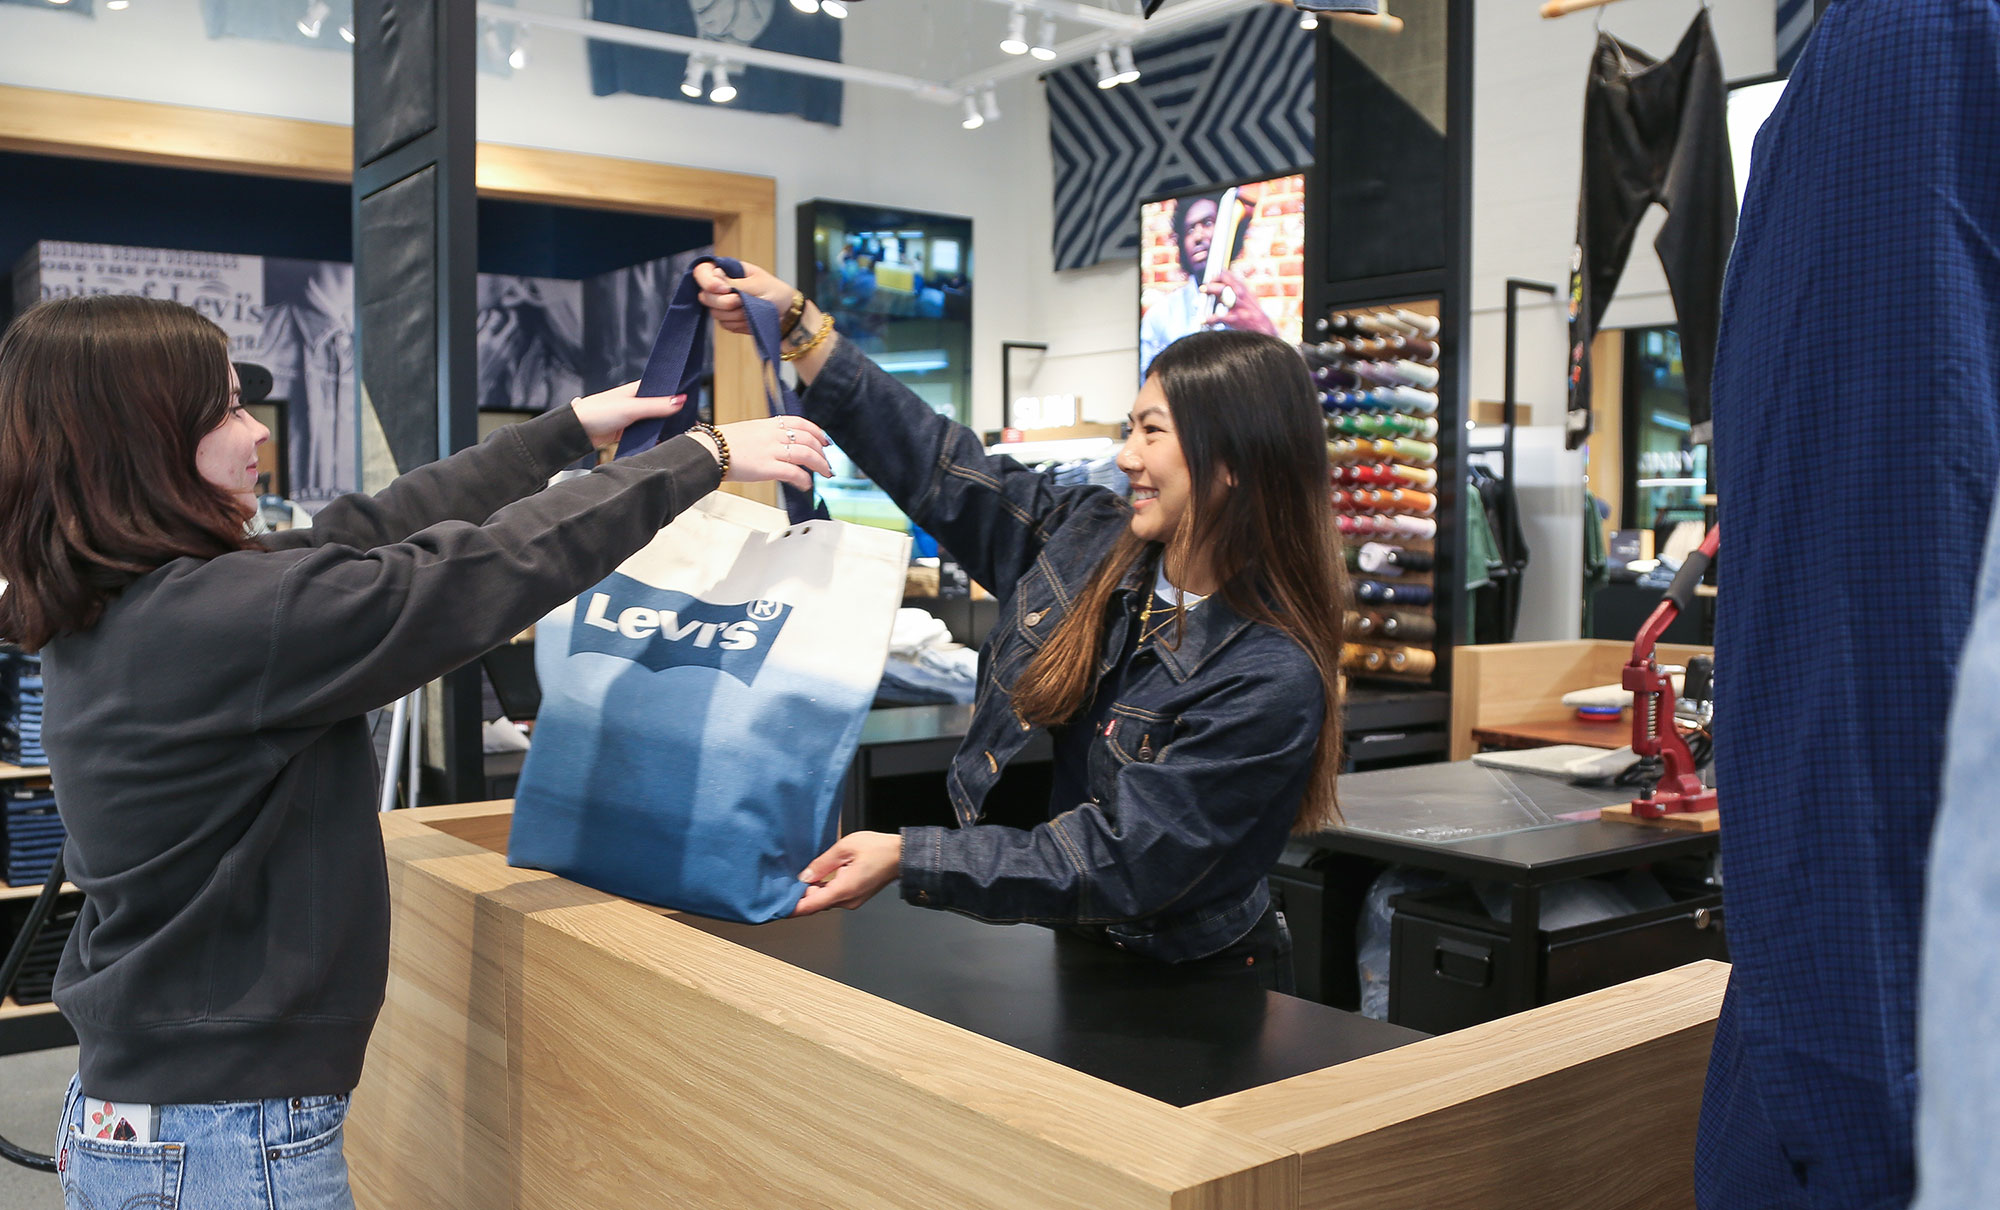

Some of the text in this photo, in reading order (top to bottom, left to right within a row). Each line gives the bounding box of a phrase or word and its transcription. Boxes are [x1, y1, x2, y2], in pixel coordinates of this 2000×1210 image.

[93, 261, 137, 276] THE
[145, 264, 220, 280] PUBLIC
[583, 592, 759, 650] Levi's
